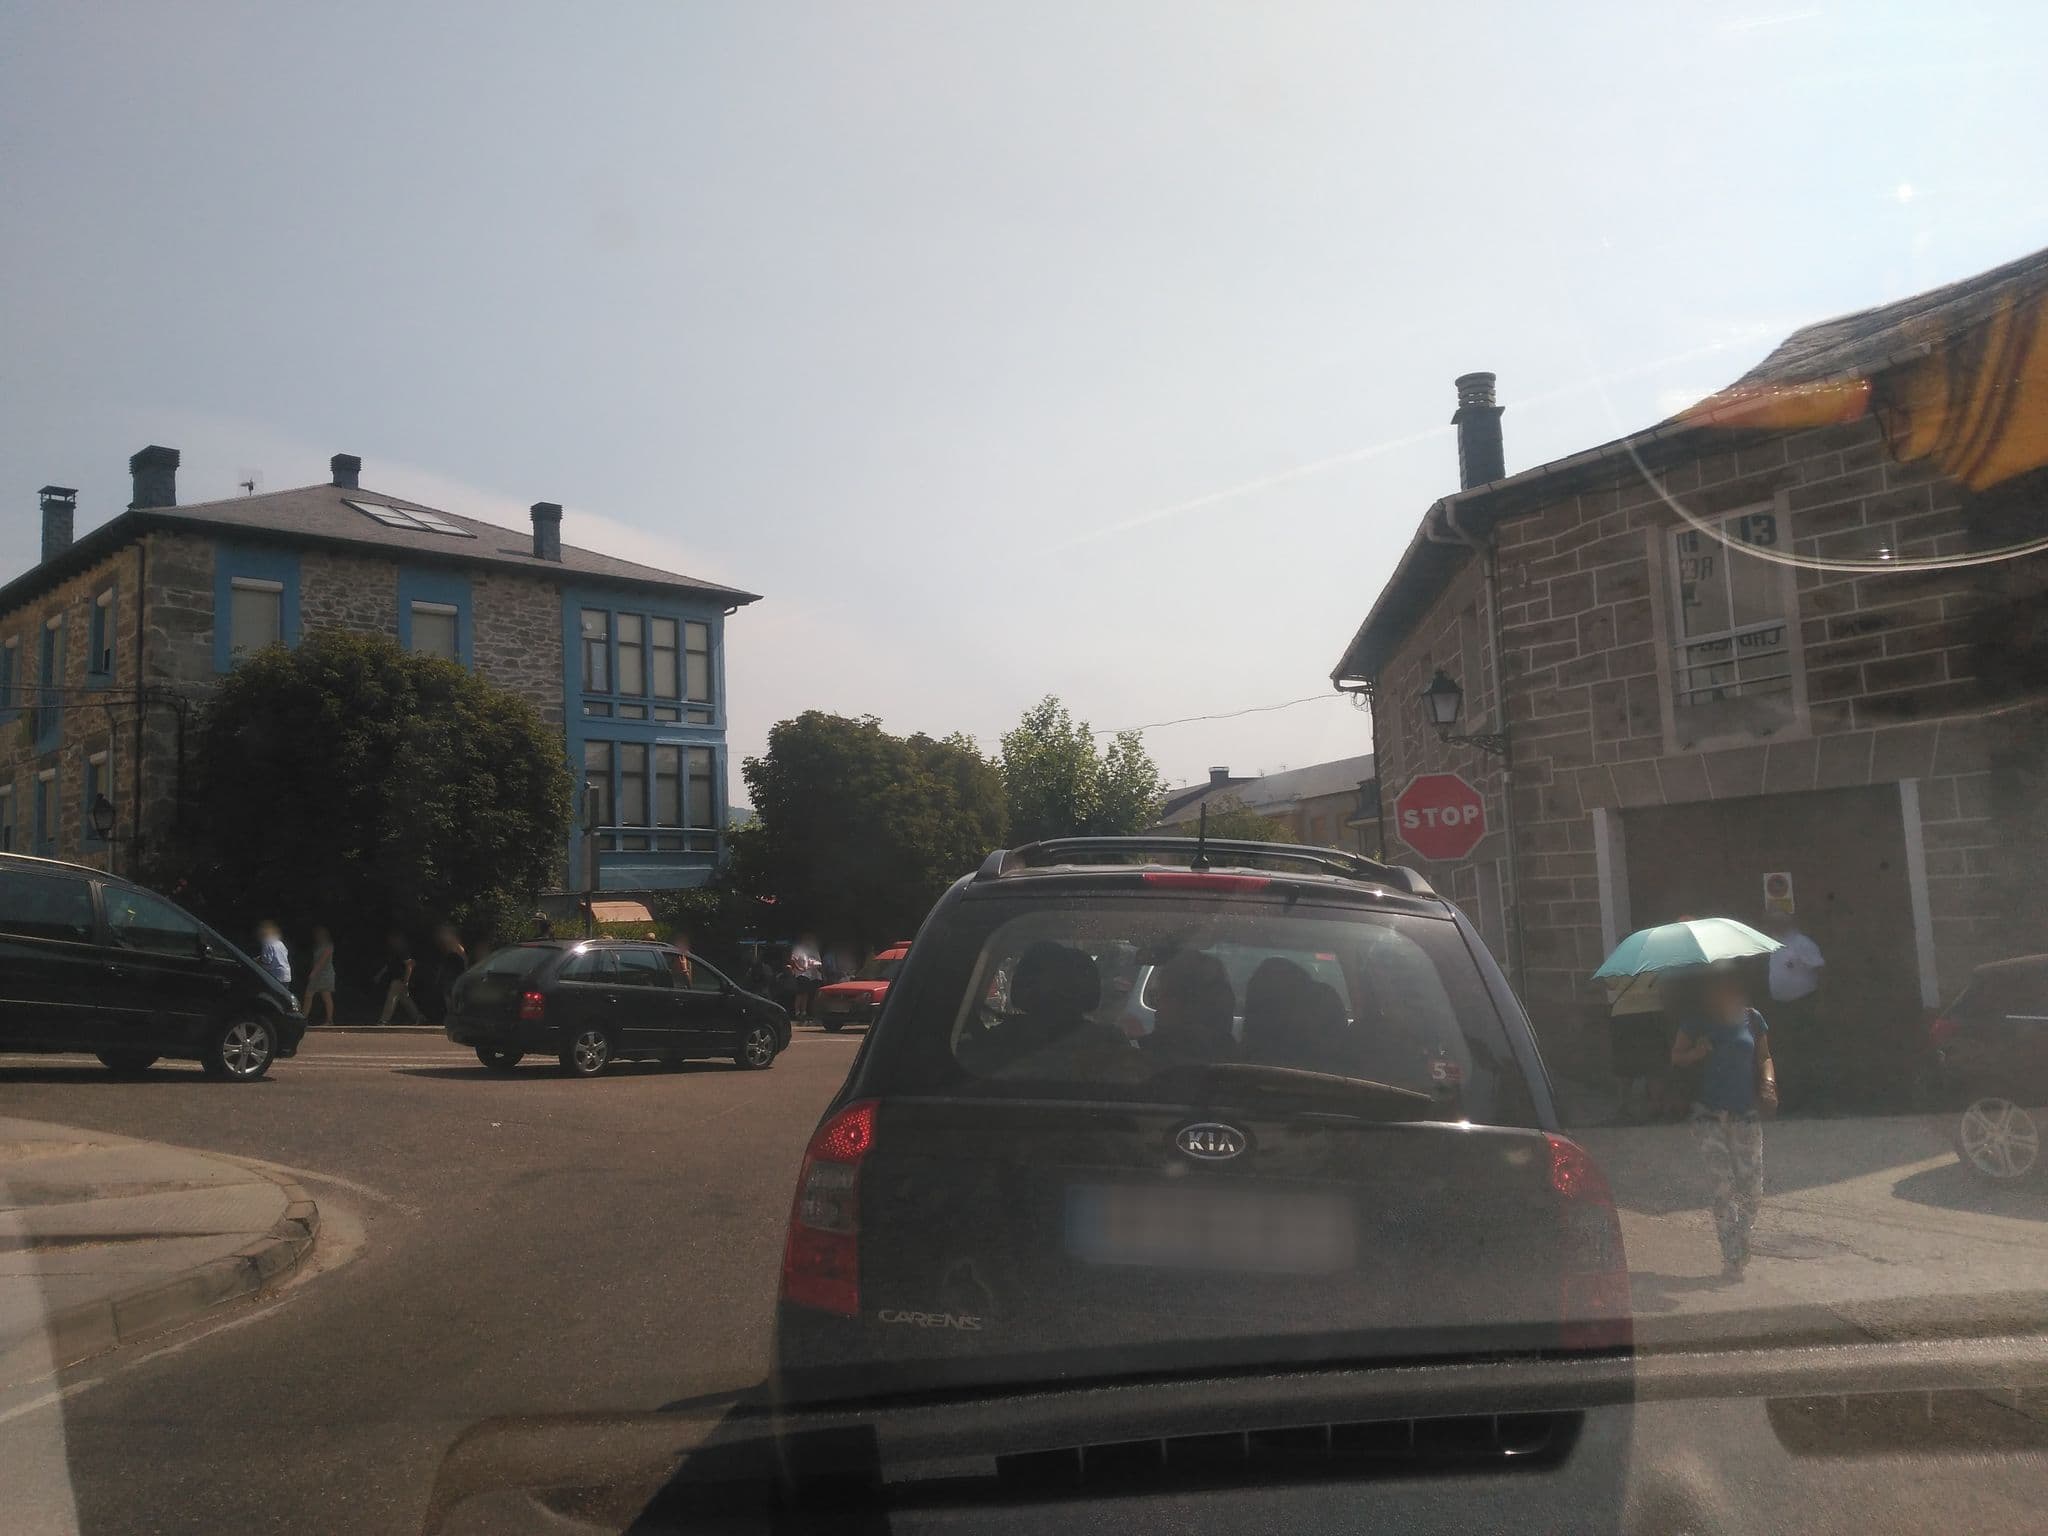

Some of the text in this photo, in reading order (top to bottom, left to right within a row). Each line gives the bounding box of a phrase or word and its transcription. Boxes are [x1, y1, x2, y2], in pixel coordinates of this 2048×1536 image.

[1403, 804, 1479, 829] STOP
[1188, 1131, 1235, 1152] KIA
[878, 1310, 982, 1330] CARENS
